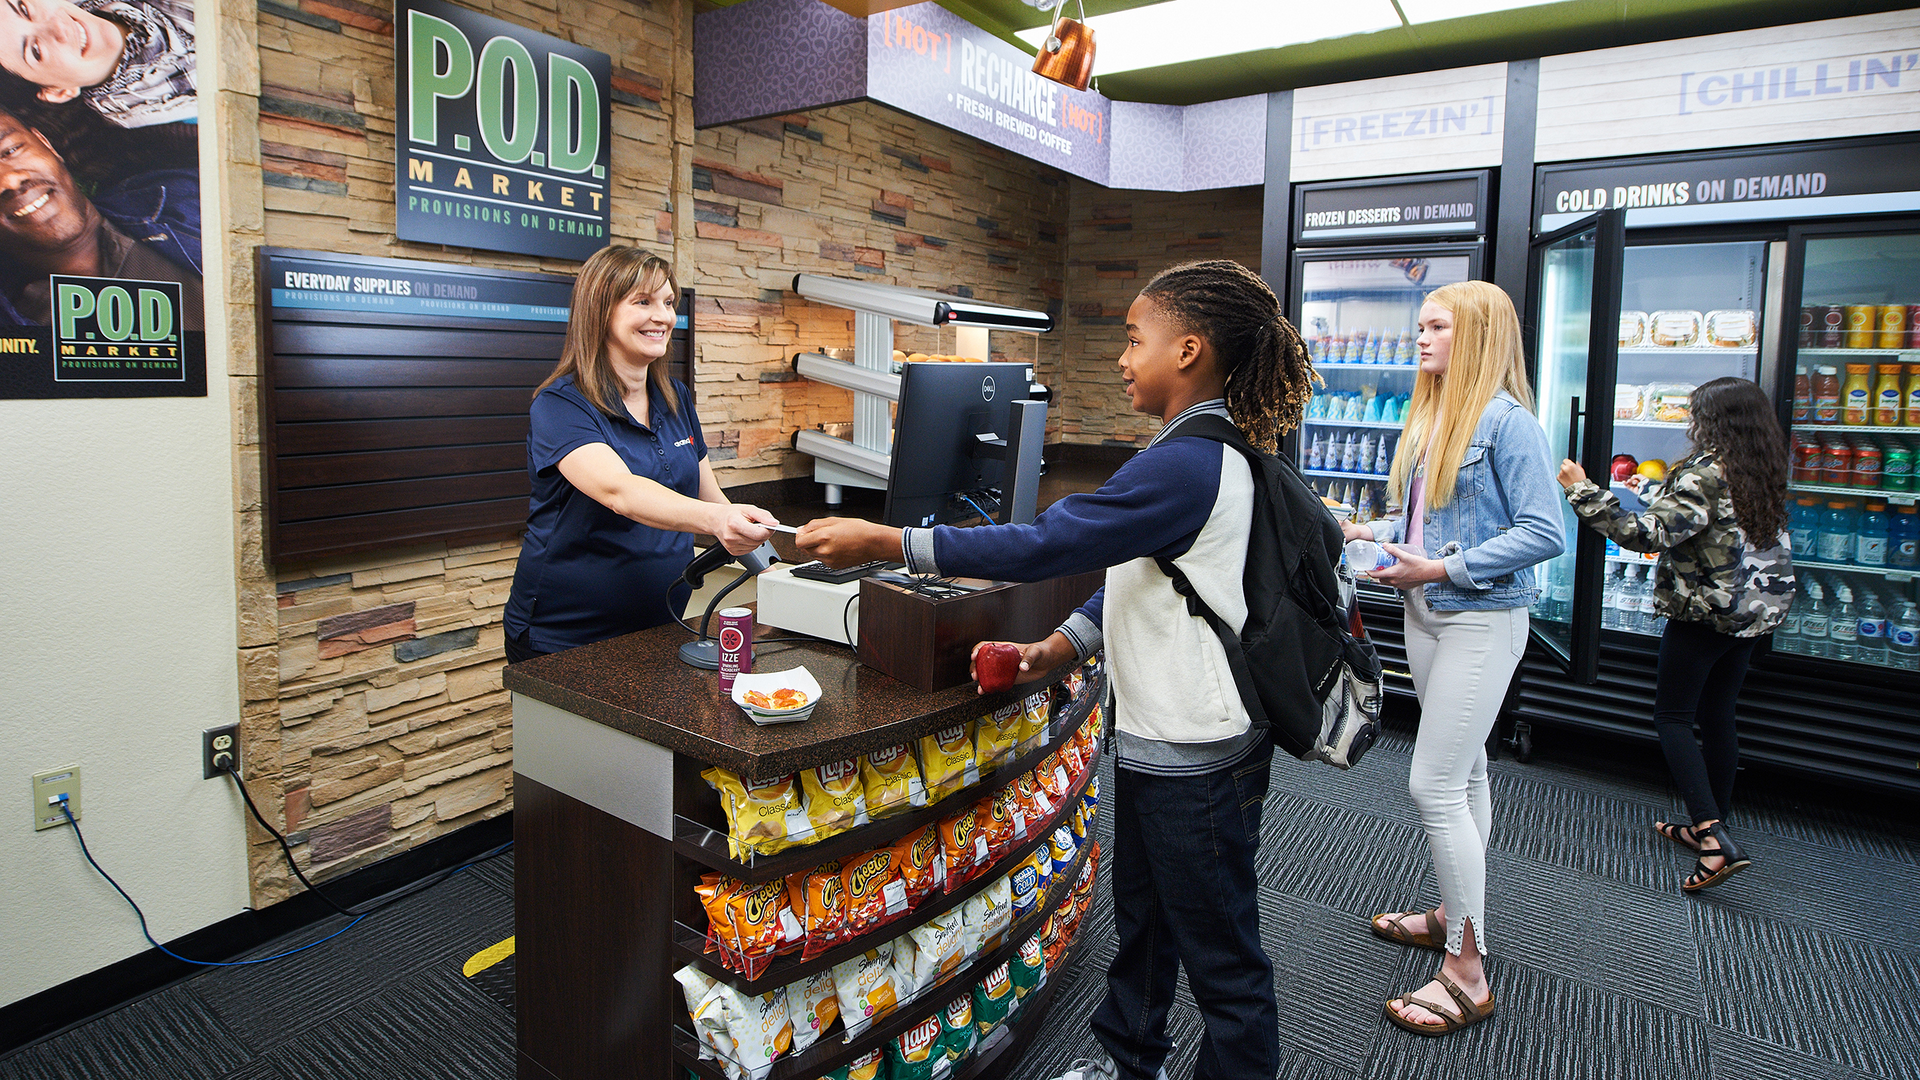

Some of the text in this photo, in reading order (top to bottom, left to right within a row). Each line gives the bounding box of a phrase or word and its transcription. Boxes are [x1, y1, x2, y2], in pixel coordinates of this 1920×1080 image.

[407, 8, 605, 179] P.O.D.
[961, 37, 1058, 127] RECHARGE
[956, 92, 1073, 156] FRESH BREWED COFFEE
[408, 158, 603, 211] MARKET
[1556, 172, 1827, 213] COLD DRINKS ON DEMAND
[408, 195, 604, 238] PROVISIONS ON DEMAND
[1304, 202, 1474, 228] FROZEN DESSERTS ON DEMAND
[284, 271, 478, 300] EVERYDAY SUPPLIES ON DEMAND
[284, 291, 395, 306] PROVISIONS ON DEMAND
[57, 283, 178, 342] P.O.D.
[420, 299, 511, 313] PROVISIONS ON DEMAND
[530, 306, 569, 316] PROVISIONS
[60, 345, 178, 357] MARKET
[61, 360, 178, 369] PROVISIONS ON DEMAND
[722, 652, 740, 662] IZZE
[945, 750, 970, 767] Classic
[884, 770, 913, 788] Classic
[758, 800, 792, 817] Classc
[851, 852, 890, 896] Cheetos
[746, 876, 785, 923] Cheeto
[804, 977, 834, 1000] delig
[761, 998, 787, 1033] delig
[903, 1017, 938, 1057] Lay's
